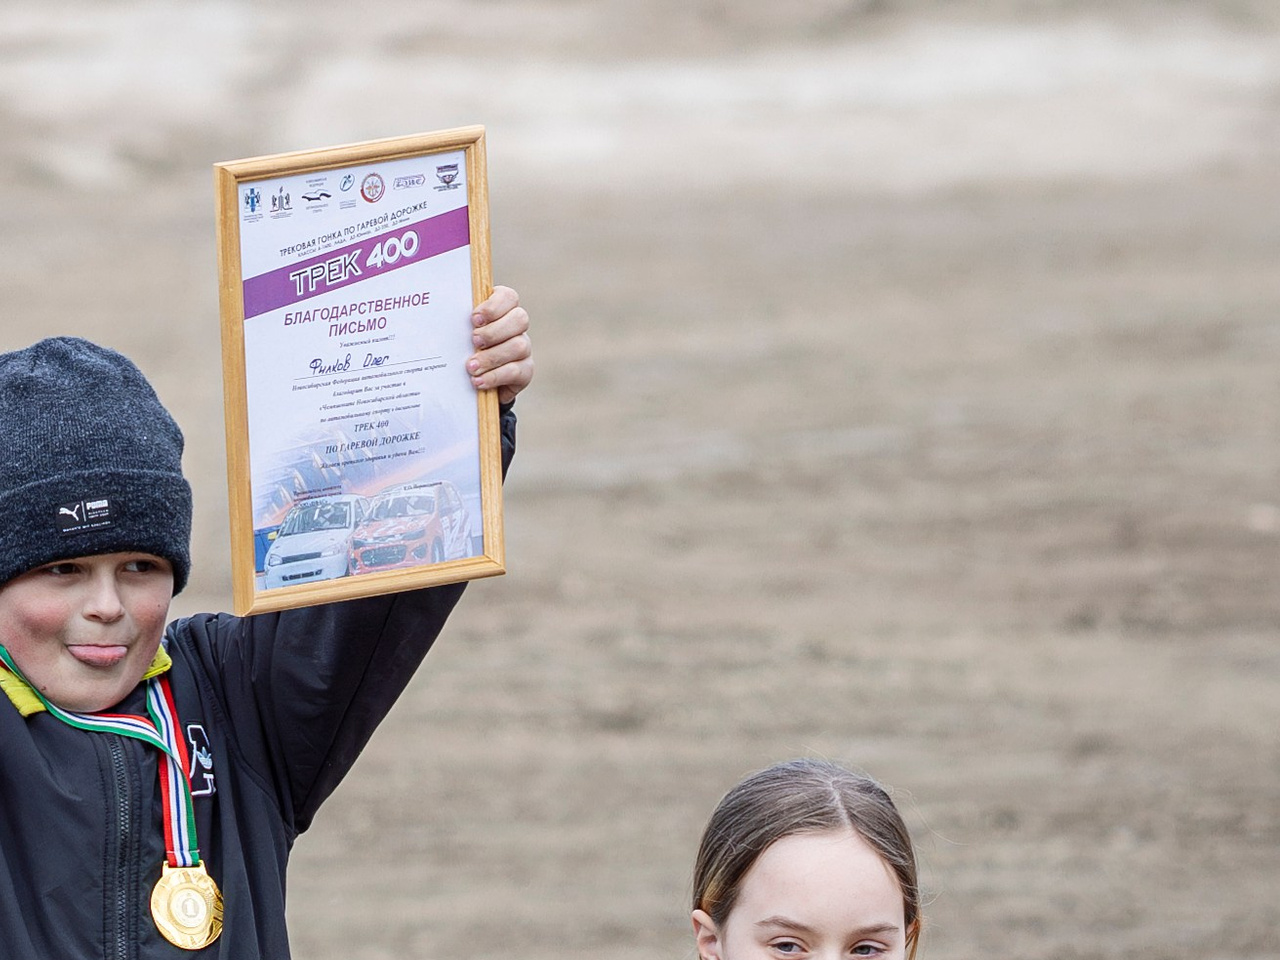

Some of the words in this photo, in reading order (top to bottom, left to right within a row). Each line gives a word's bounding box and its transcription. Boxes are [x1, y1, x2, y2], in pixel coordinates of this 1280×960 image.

[279, 238, 315, 256] ТРЕКОВАЯ
[317, 230, 342, 244] ГОНКА
[343, 225, 354, 235] ПО
[356, 212, 388, 230] ГАРЕВОЙ
[390, 201, 426, 220] ДОРОЖКЕ
[290, 249, 363, 296] ТРЕК
[365, 230, 419, 268] 400
[284, 292, 429, 325] БЛАГОДАРСТВЕННОЕ
[328, 316, 386, 336] ПИСЬМО
[353, 421, 375, 432] ТРЕК
[375, 419, 389, 428] 400
[324, 444, 338, 454] ПО
[338, 437, 379, 452] ГАРЕВОЙ
[378, 431, 421, 446] ДОРОЖКЕ
